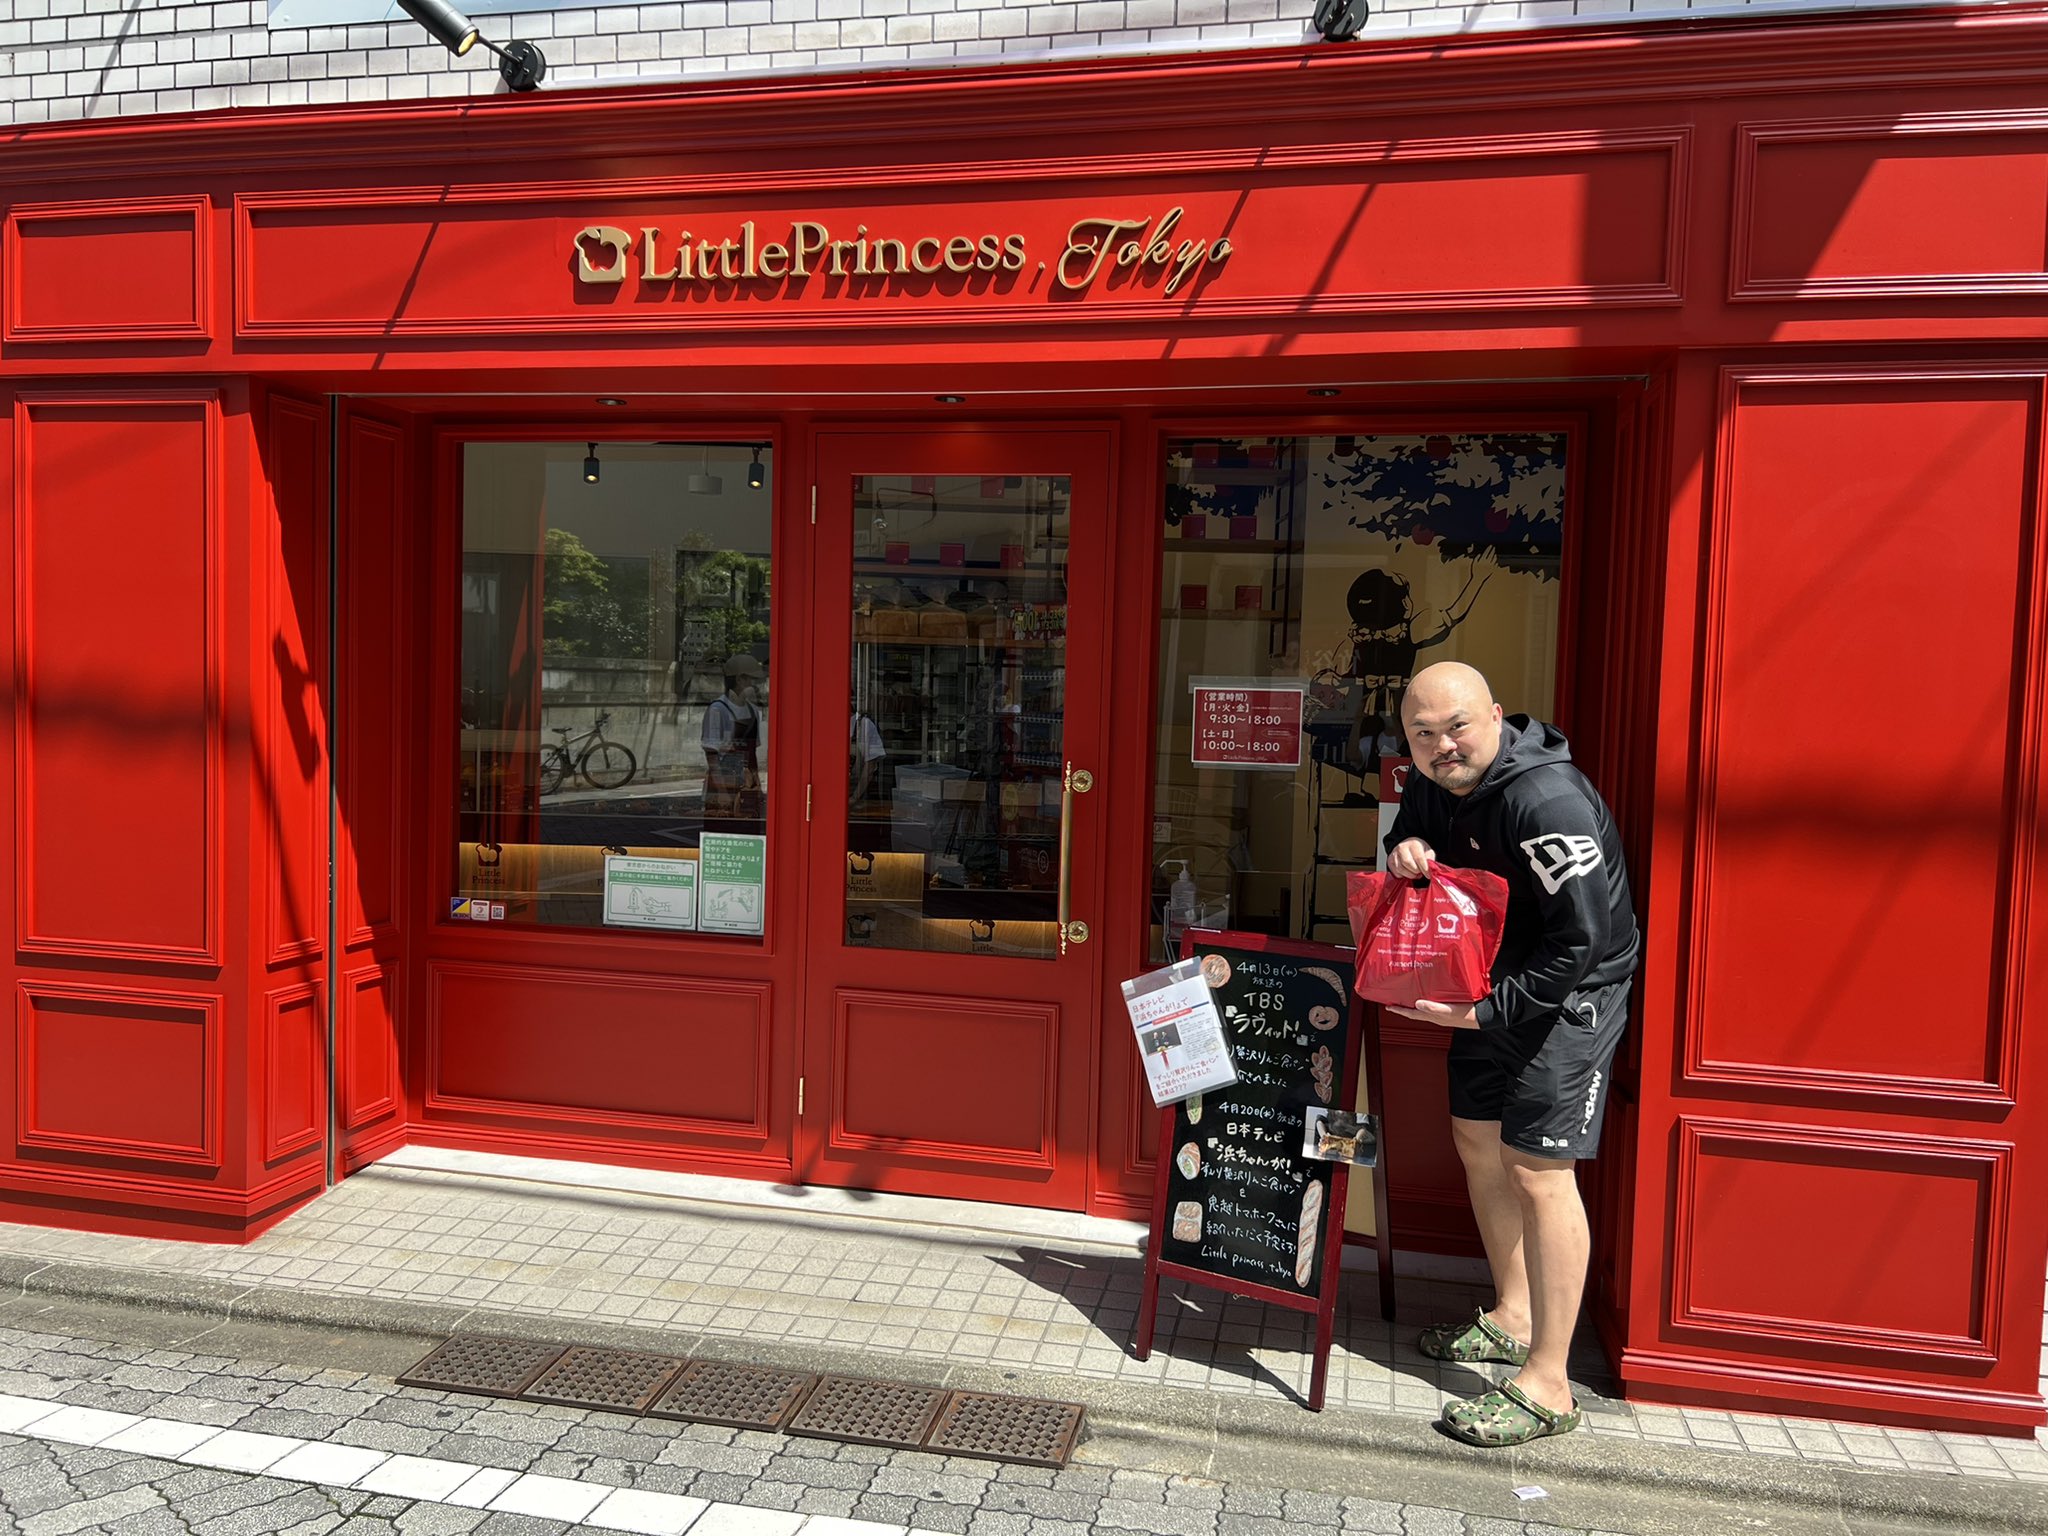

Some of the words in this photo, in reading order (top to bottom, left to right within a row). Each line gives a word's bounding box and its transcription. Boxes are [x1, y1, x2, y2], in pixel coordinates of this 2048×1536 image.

[1057, 206, 1233, 295] Tokyo
[851, 877, 873, 885] Little
[1133, 995, 1165, 1013] 日本テレビ
[1243, 992, 1285, 1011] TBS
[1226, 1122, 1285, 1143] 日本テレビ
[1201, 1245, 1227, 1260] Little
